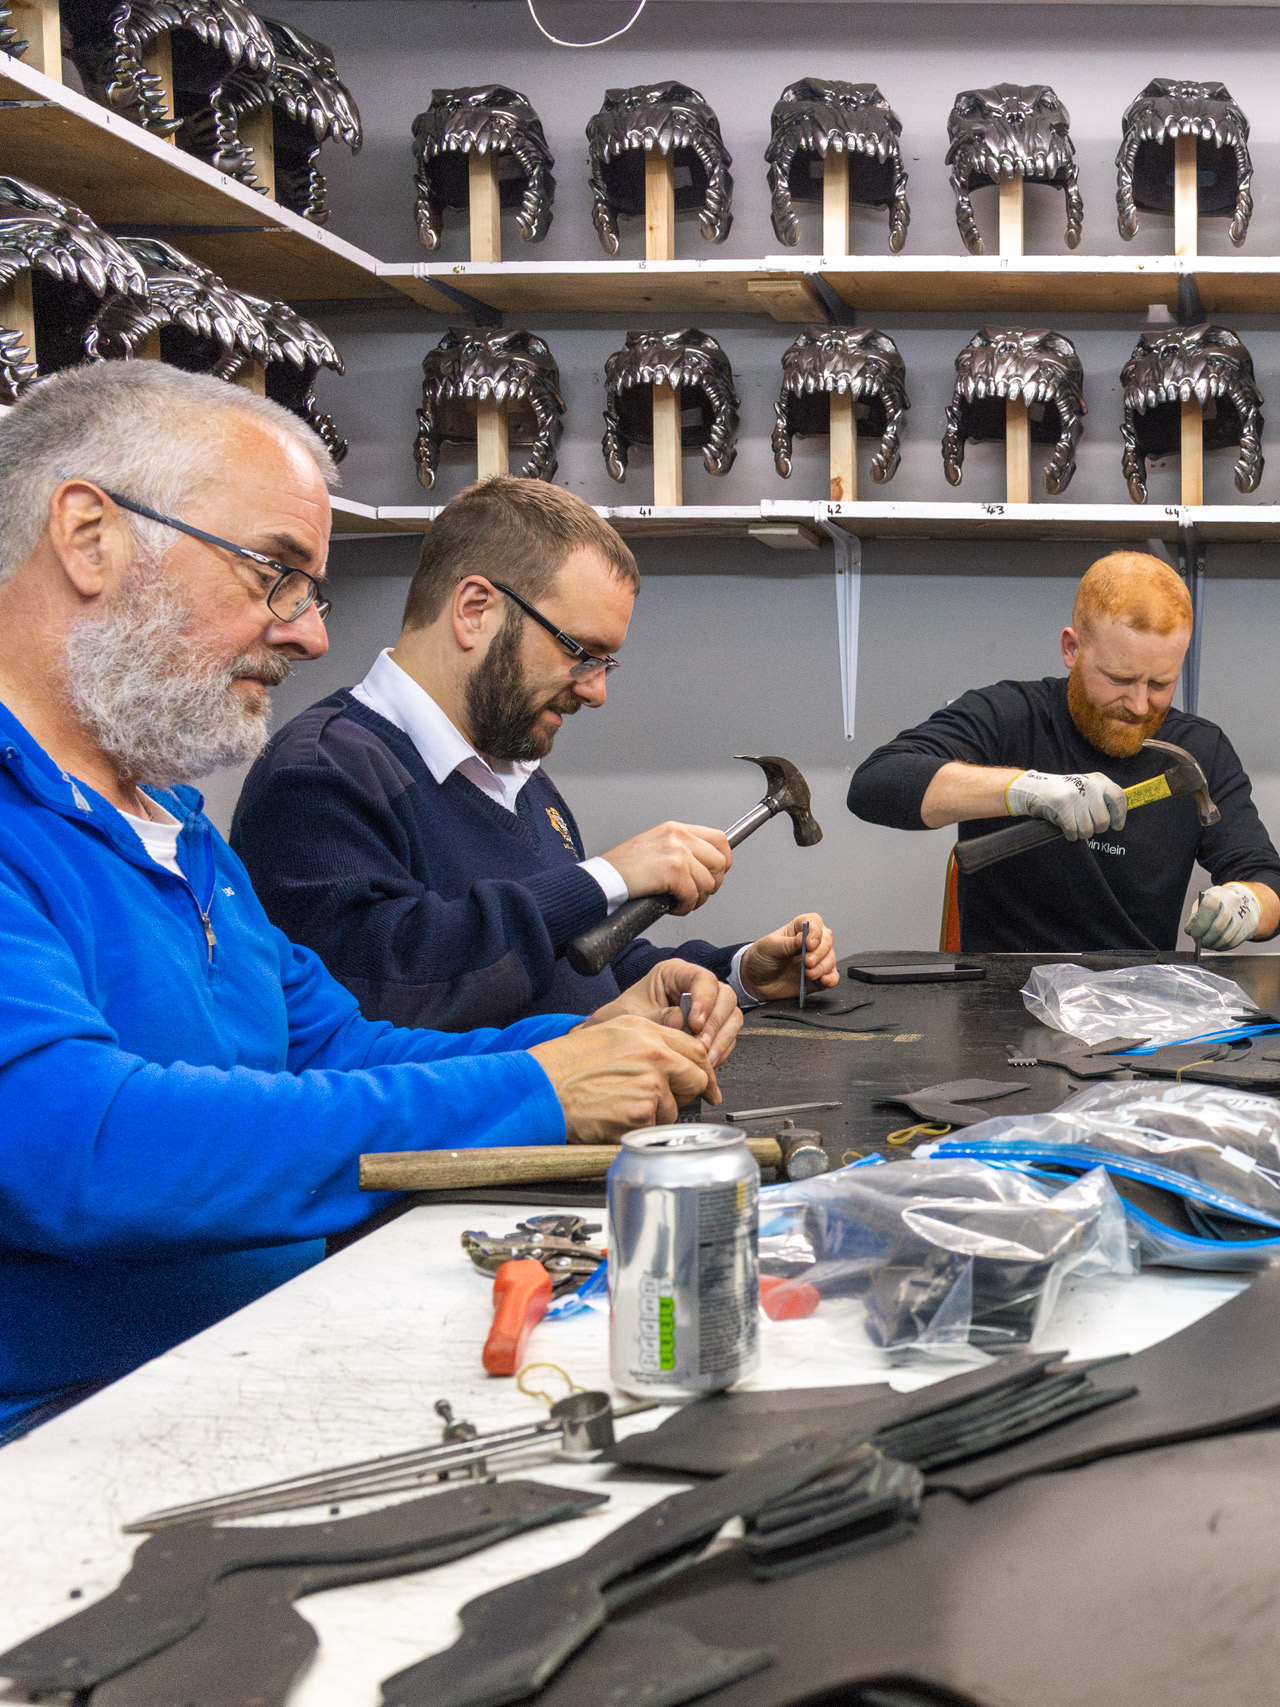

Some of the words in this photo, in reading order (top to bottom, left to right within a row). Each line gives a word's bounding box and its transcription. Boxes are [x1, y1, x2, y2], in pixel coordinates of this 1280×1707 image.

[639, 507, 652, 517] 41
[827, 504, 842, 515] 42
[987, 505, 1004, 516] 43
[1165, 507, 1179, 518] 44
[1101, 841, 1126, 856] Klein
